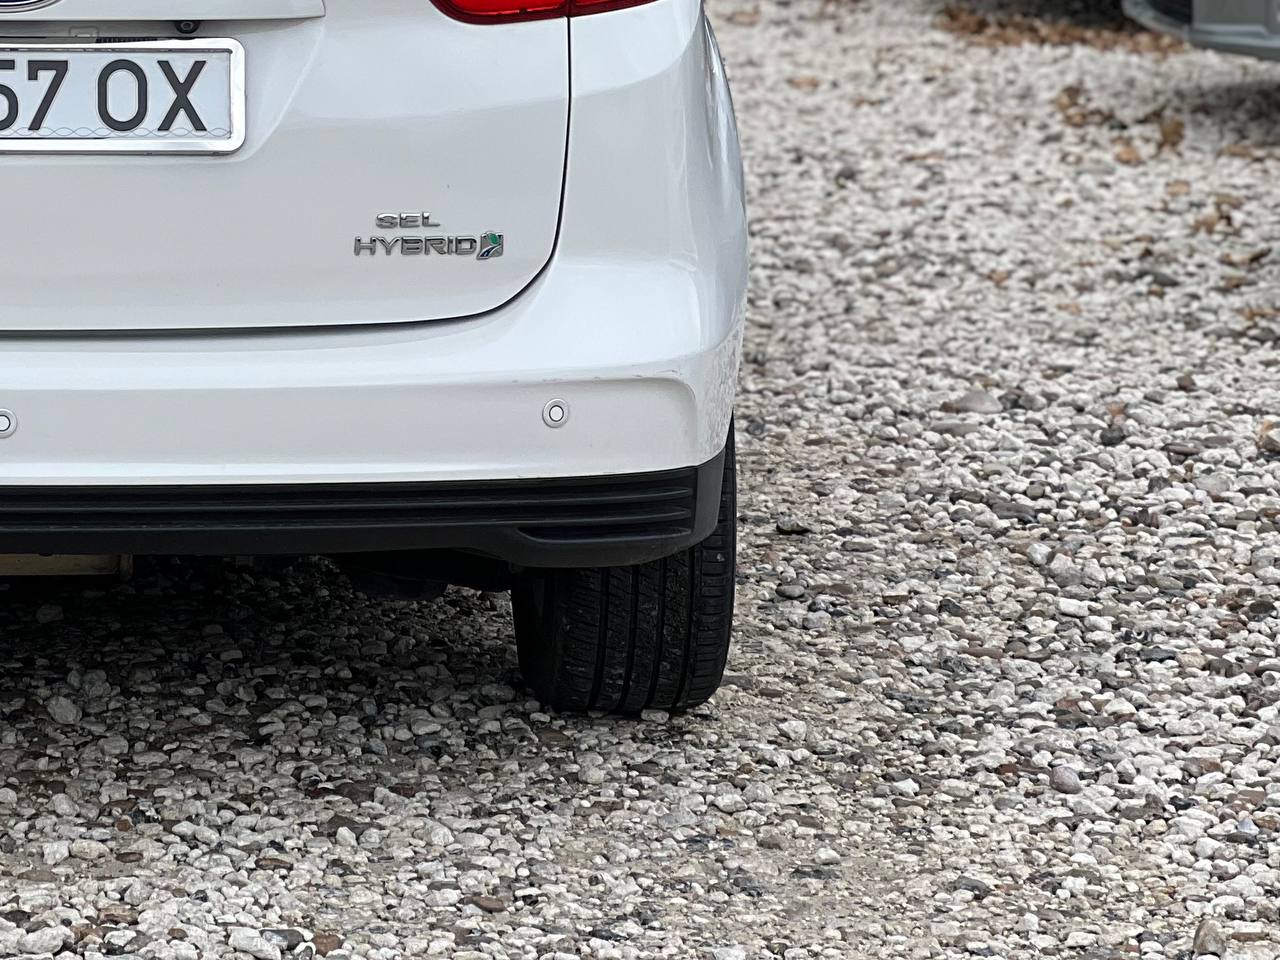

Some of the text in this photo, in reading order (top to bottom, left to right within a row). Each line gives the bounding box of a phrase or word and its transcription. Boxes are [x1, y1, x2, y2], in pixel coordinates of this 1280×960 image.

[97, 58, 208, 132] OX
[375, 211, 441, 229] SEL
[353, 235, 478, 257] HYBRID
